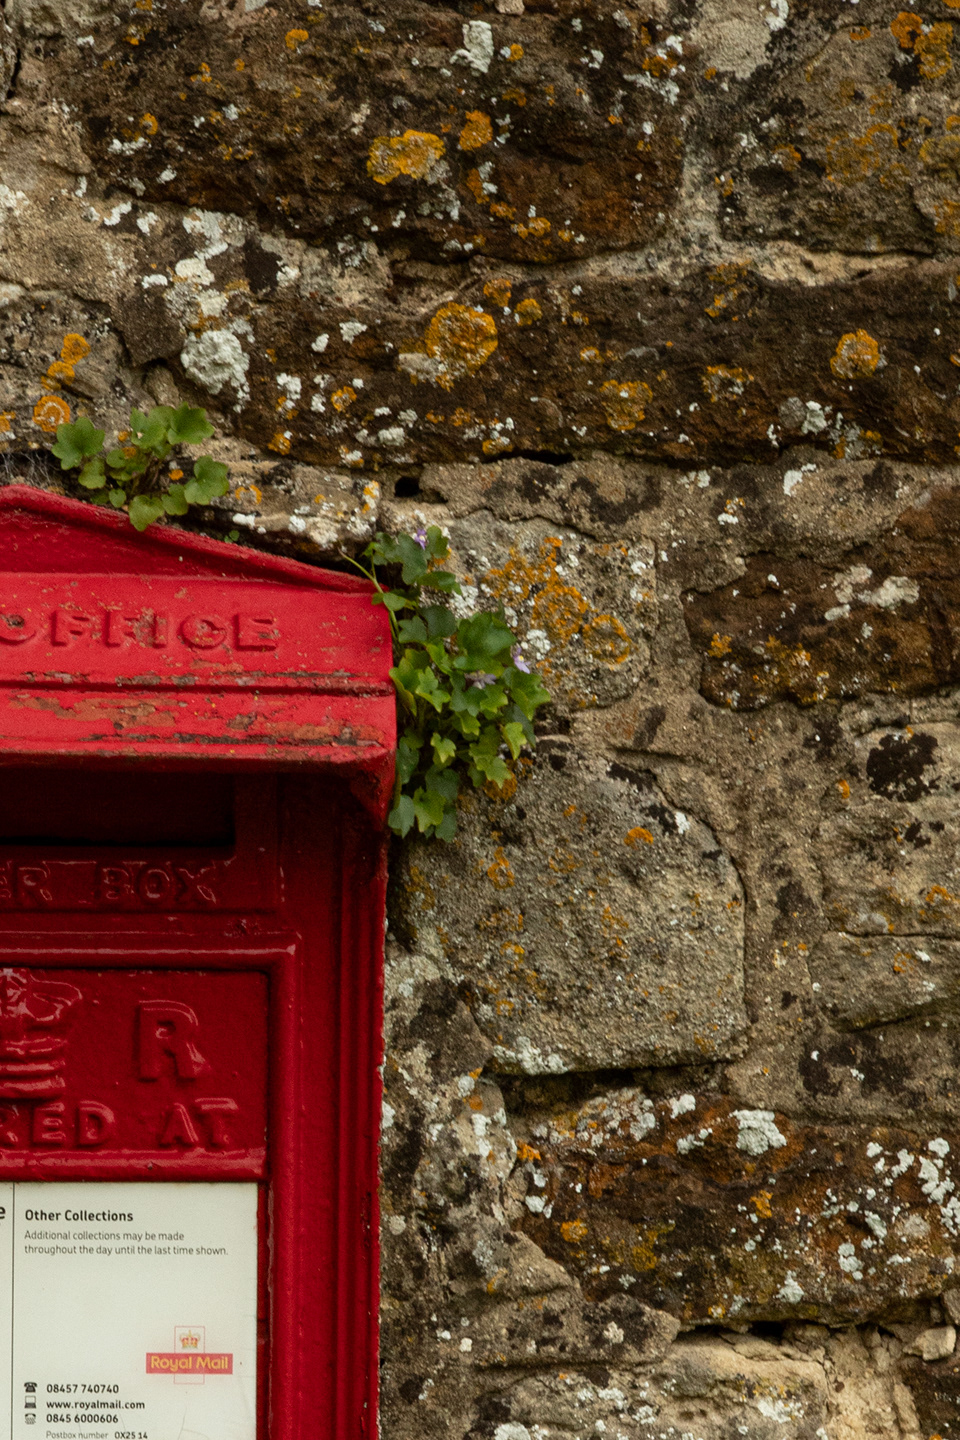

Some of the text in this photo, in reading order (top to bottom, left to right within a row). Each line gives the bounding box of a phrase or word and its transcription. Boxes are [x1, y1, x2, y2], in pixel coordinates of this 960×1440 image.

[99, 865, 218, 904] BOX
[135, 999, 211, 1080] R
[157, 1098, 240, 1147] AT
[24, 1208, 134, 1222] Other Collections
[24, 1229, 185, 1243] Additional collections may be made
[24, 1244, 229, 1256] throughout the day until the last time shown.
[151, 1356, 229, 1372] Royal Mail
[46, 1383, 120, 1394] 08457 740740
[46, 1399, 146, 1411] www.royalmail.com
[46, 1413, 119, 1424] 0845 6000606
[45, 1430, 77, 1440] Postbox
[78, 1431, 109, 1440] number
[138, 1431, 149, 1440] 14
